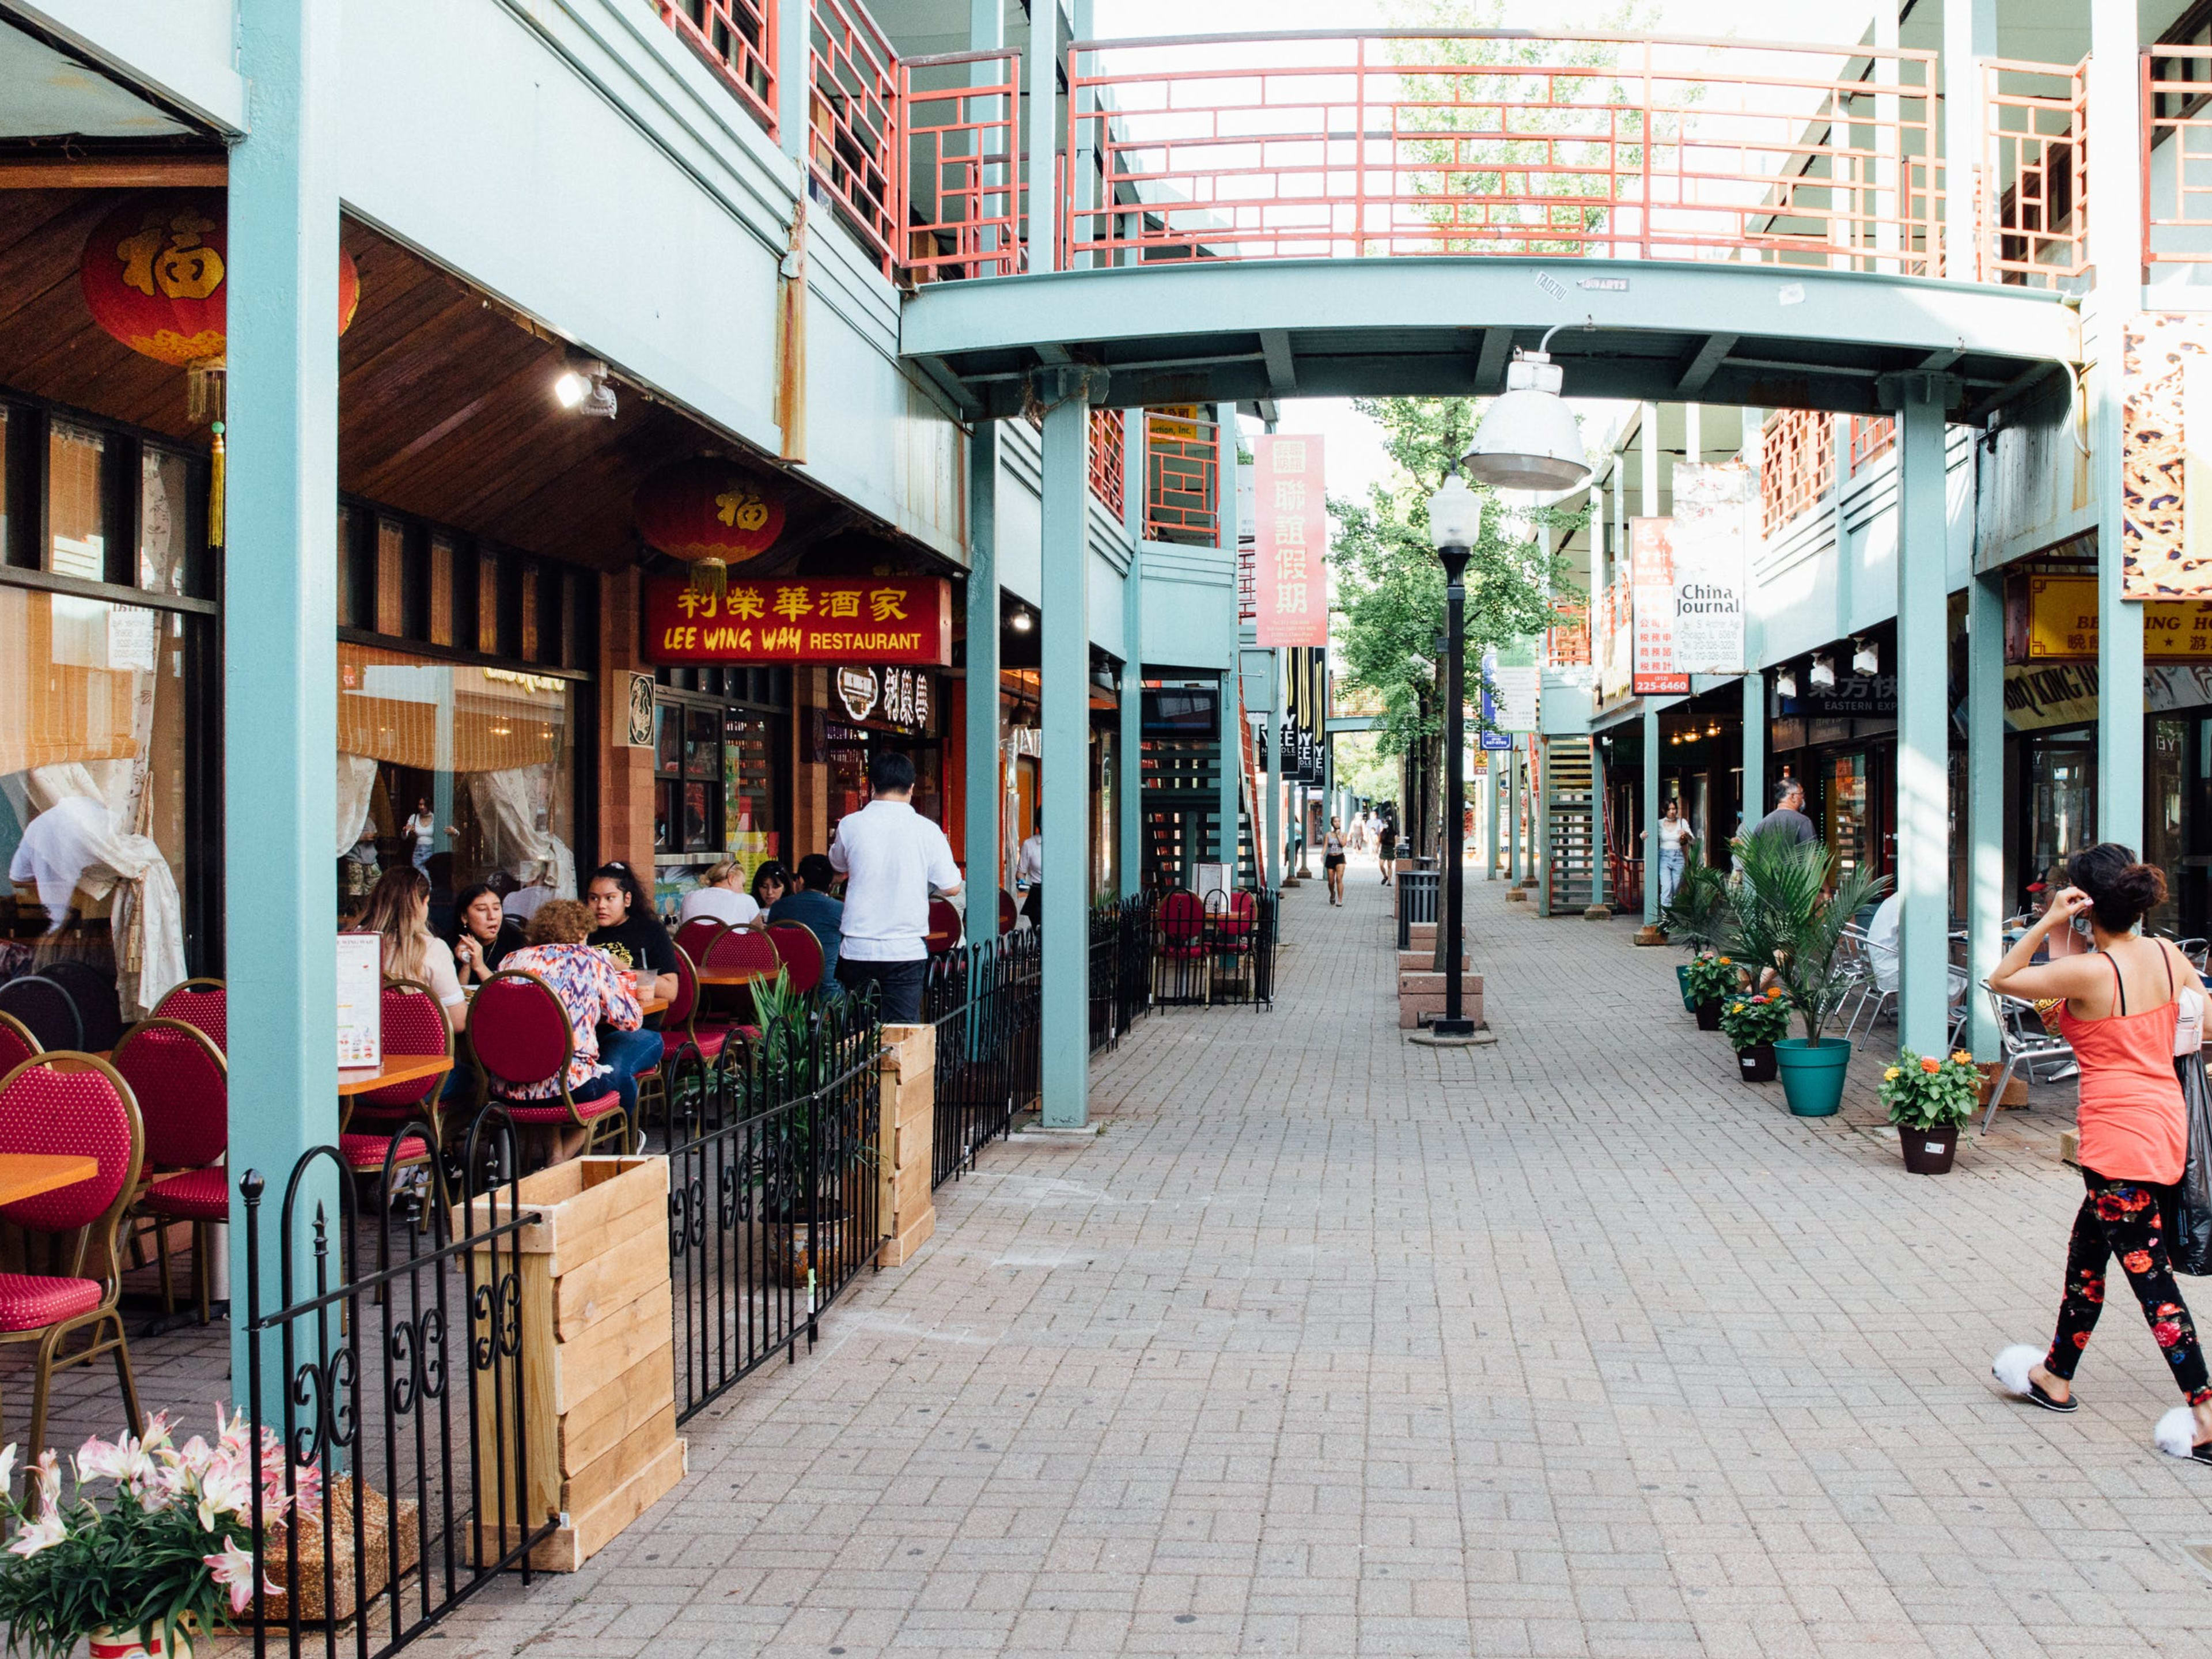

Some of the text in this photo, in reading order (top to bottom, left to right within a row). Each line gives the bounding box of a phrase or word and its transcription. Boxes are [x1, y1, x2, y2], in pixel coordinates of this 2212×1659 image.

[1682, 584, 1733, 600] China
[677, 586, 908, 622] 利榮華酒家
[1677, 598, 1739, 617] Journal
[664, 626, 922, 654] LEE WING WAH RESTAURANT
[1637, 682, 1687, 691] 225-6460
[2028, 665, 2082, 704] KING
[1824, 701, 1872, 710] EASTERN
